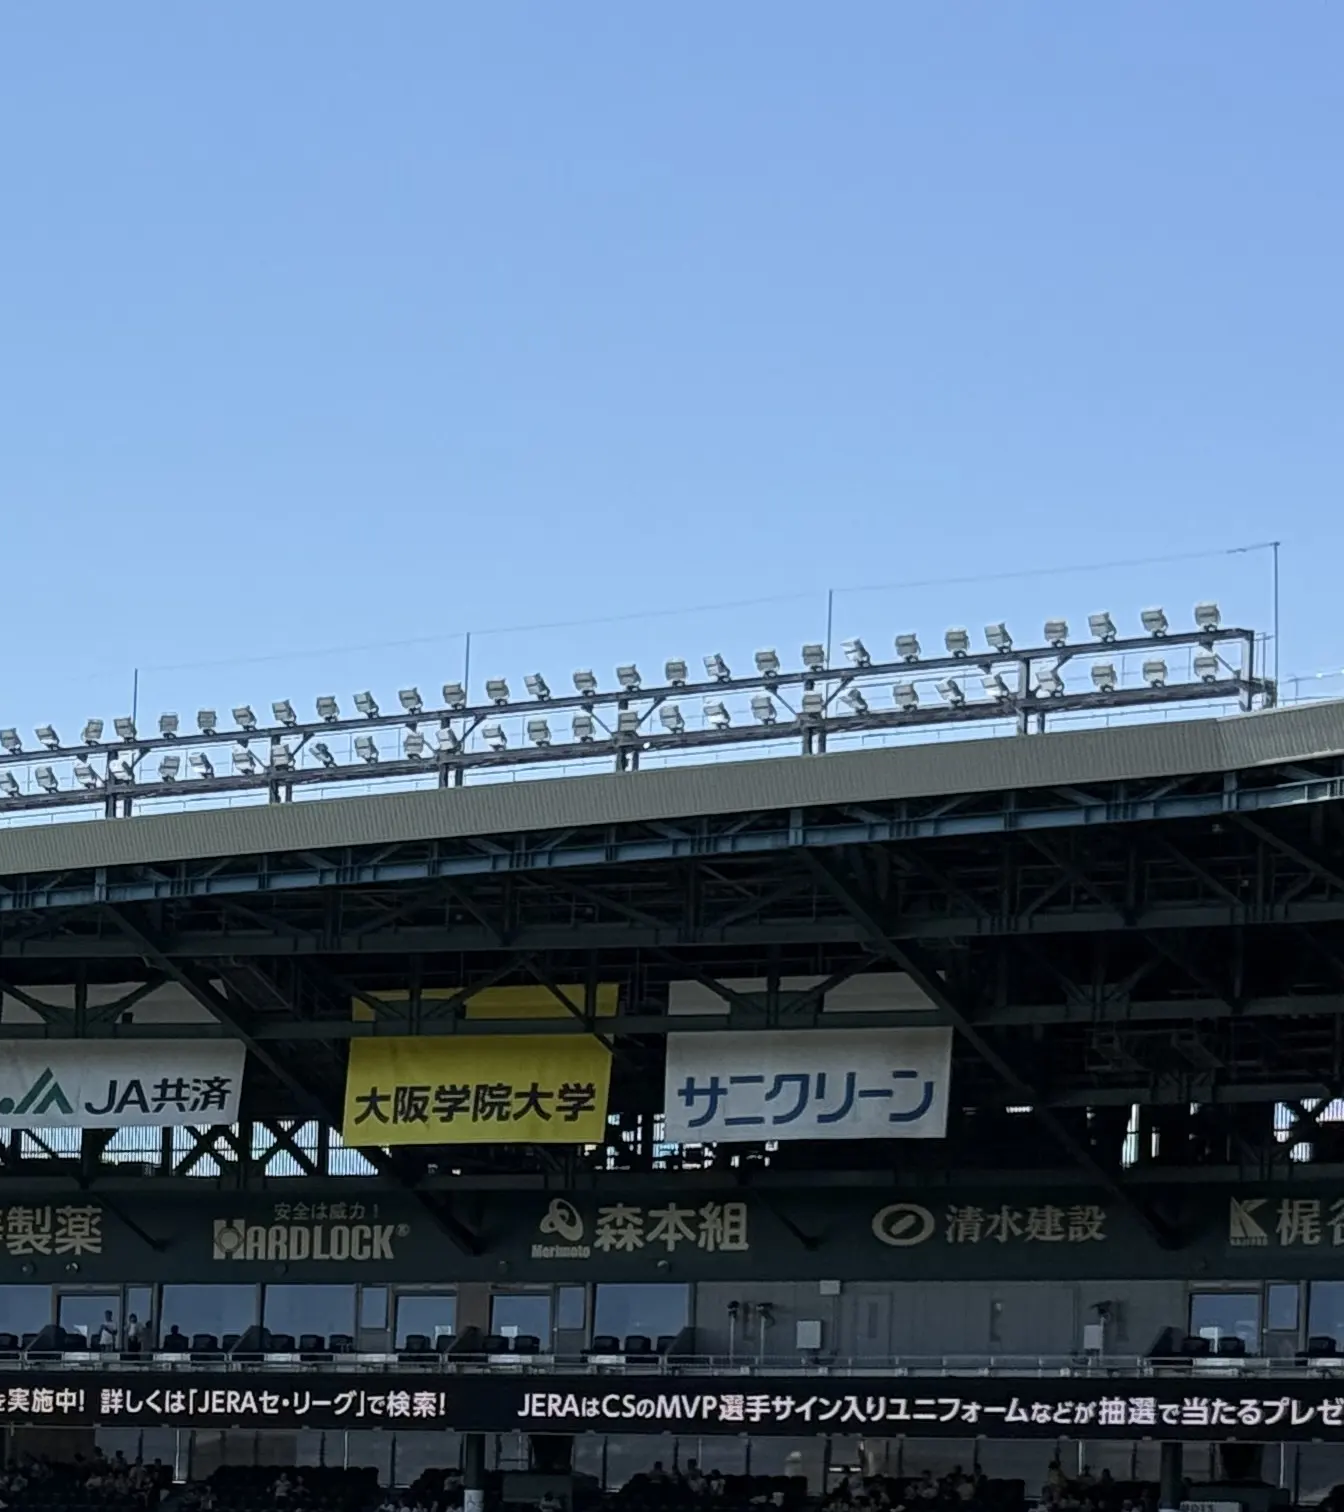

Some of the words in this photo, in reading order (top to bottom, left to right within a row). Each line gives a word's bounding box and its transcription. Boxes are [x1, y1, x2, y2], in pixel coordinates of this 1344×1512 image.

[85, 1076, 233, 1114] JA共済
[354, 1082, 597, 1124] 大阪学院大学
[678, 1070, 934, 1128] サニクリーン
[594, 1202, 749, 1253] 森本組
[945, 1205, 1107, 1243] 清水建設
